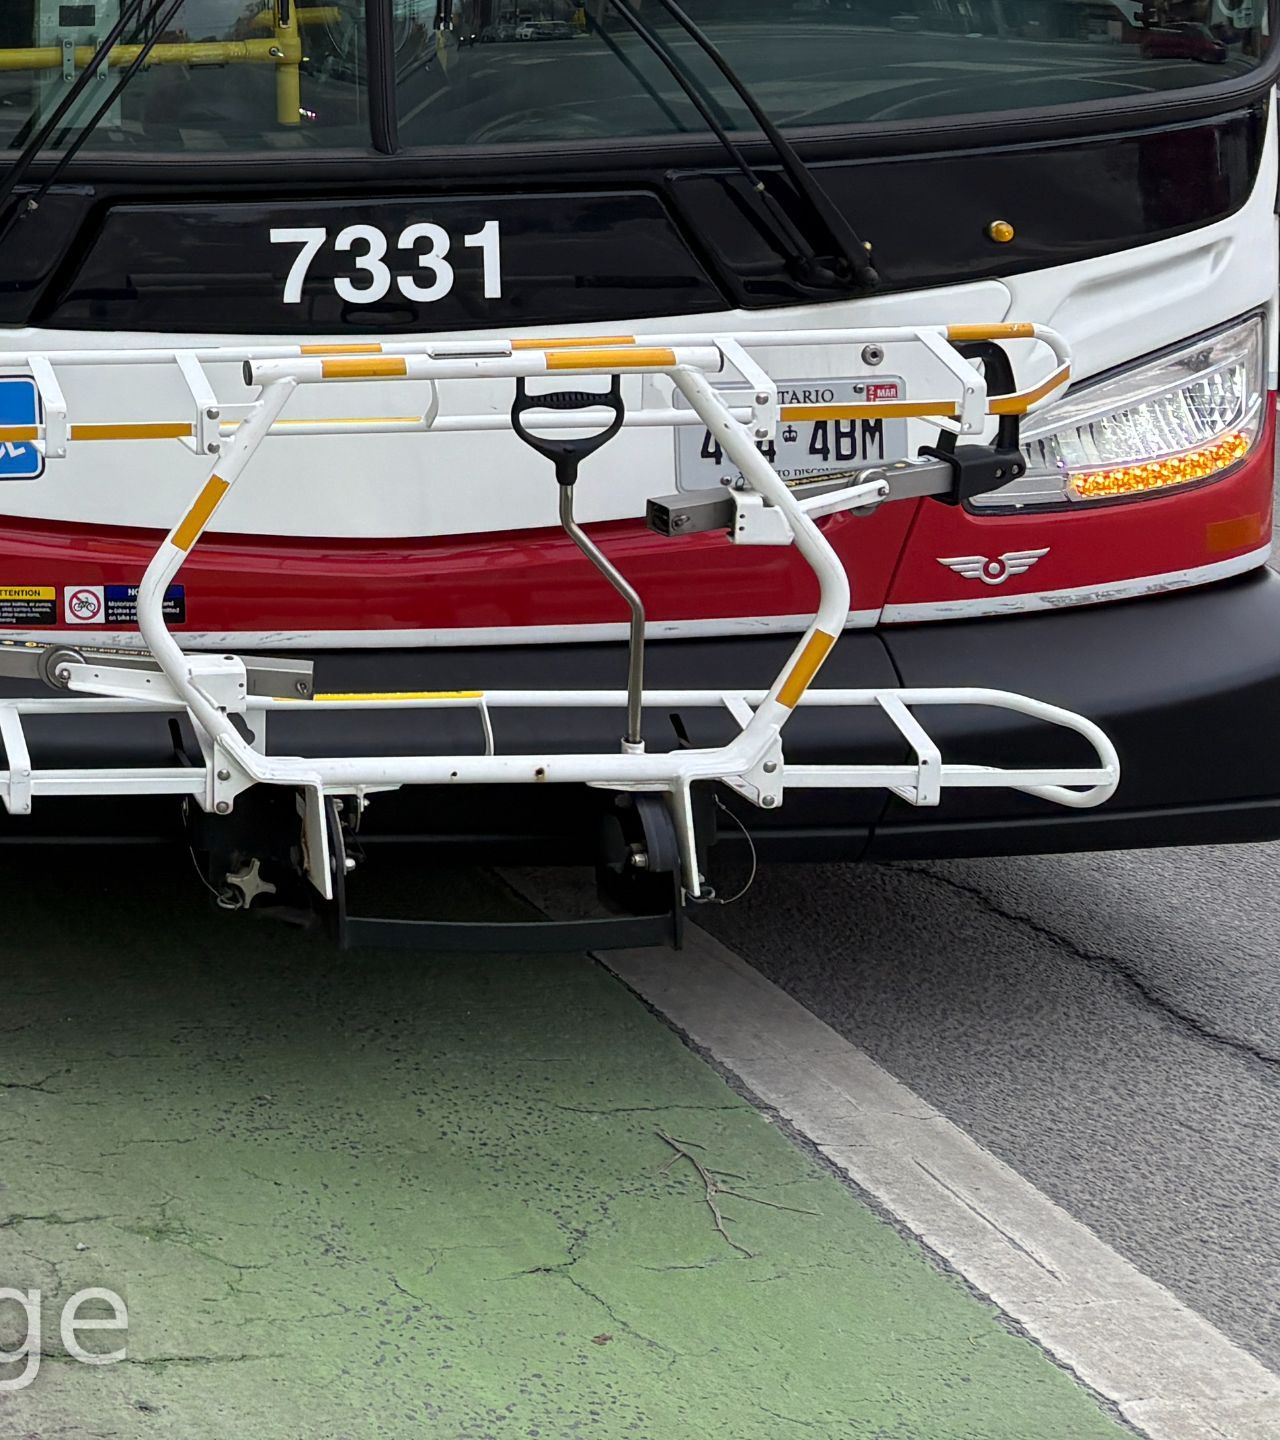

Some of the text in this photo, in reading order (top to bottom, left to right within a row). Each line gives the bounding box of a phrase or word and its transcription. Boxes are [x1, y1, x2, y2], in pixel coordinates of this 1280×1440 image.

[269, 220, 505, 303] 7331
[777, 388, 834, 405] TARIO
[876, 387, 897, 399] MAR
[808, 417, 885, 462] 4BM
